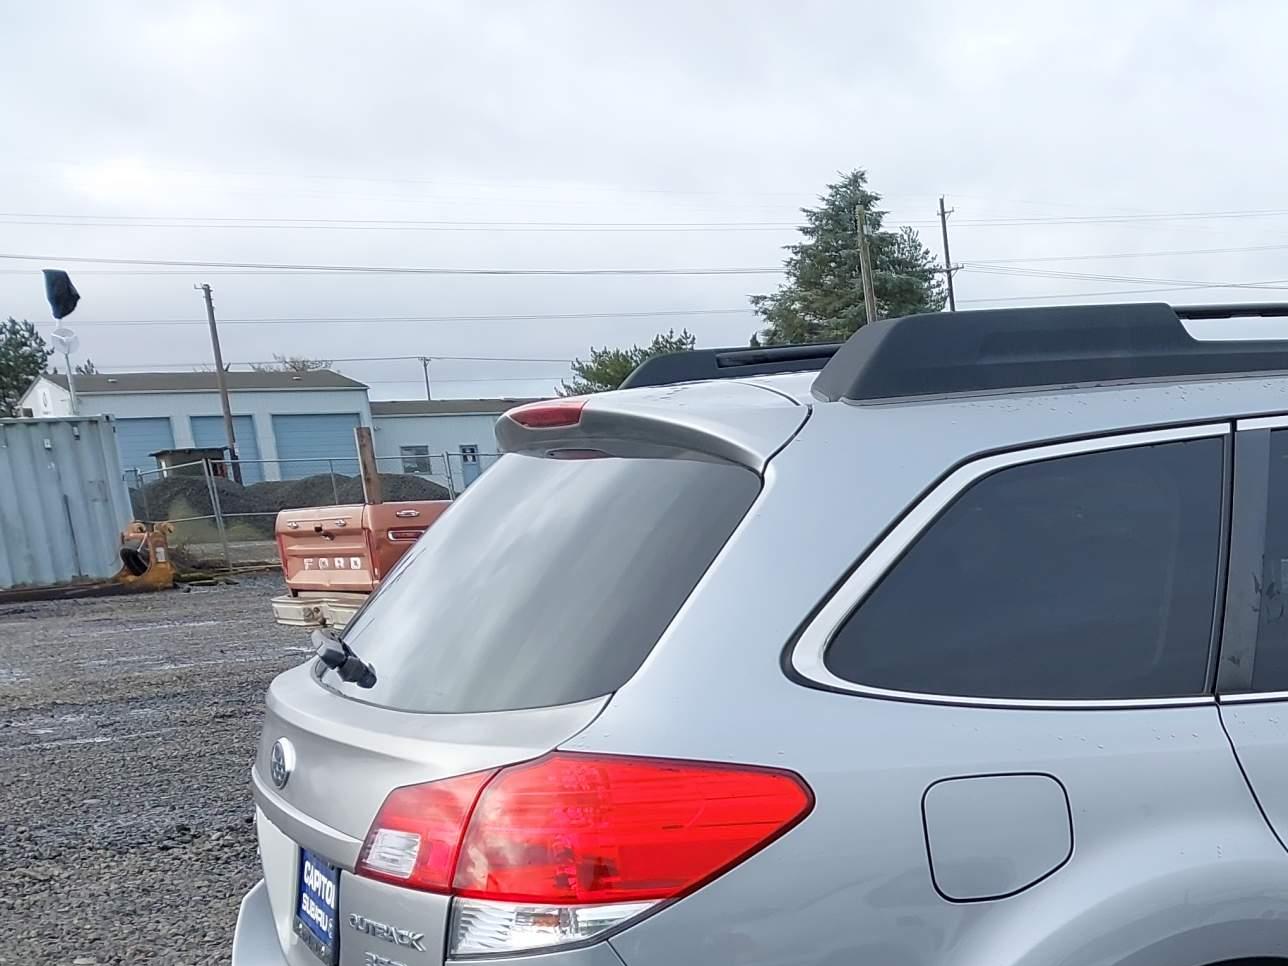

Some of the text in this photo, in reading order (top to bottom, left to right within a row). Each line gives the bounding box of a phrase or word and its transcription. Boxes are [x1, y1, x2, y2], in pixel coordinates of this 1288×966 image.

[303, 557, 361, 570] FORD
[301, 892, 329, 932] SUBARU
[349, 912, 428, 953] OUTBACK
